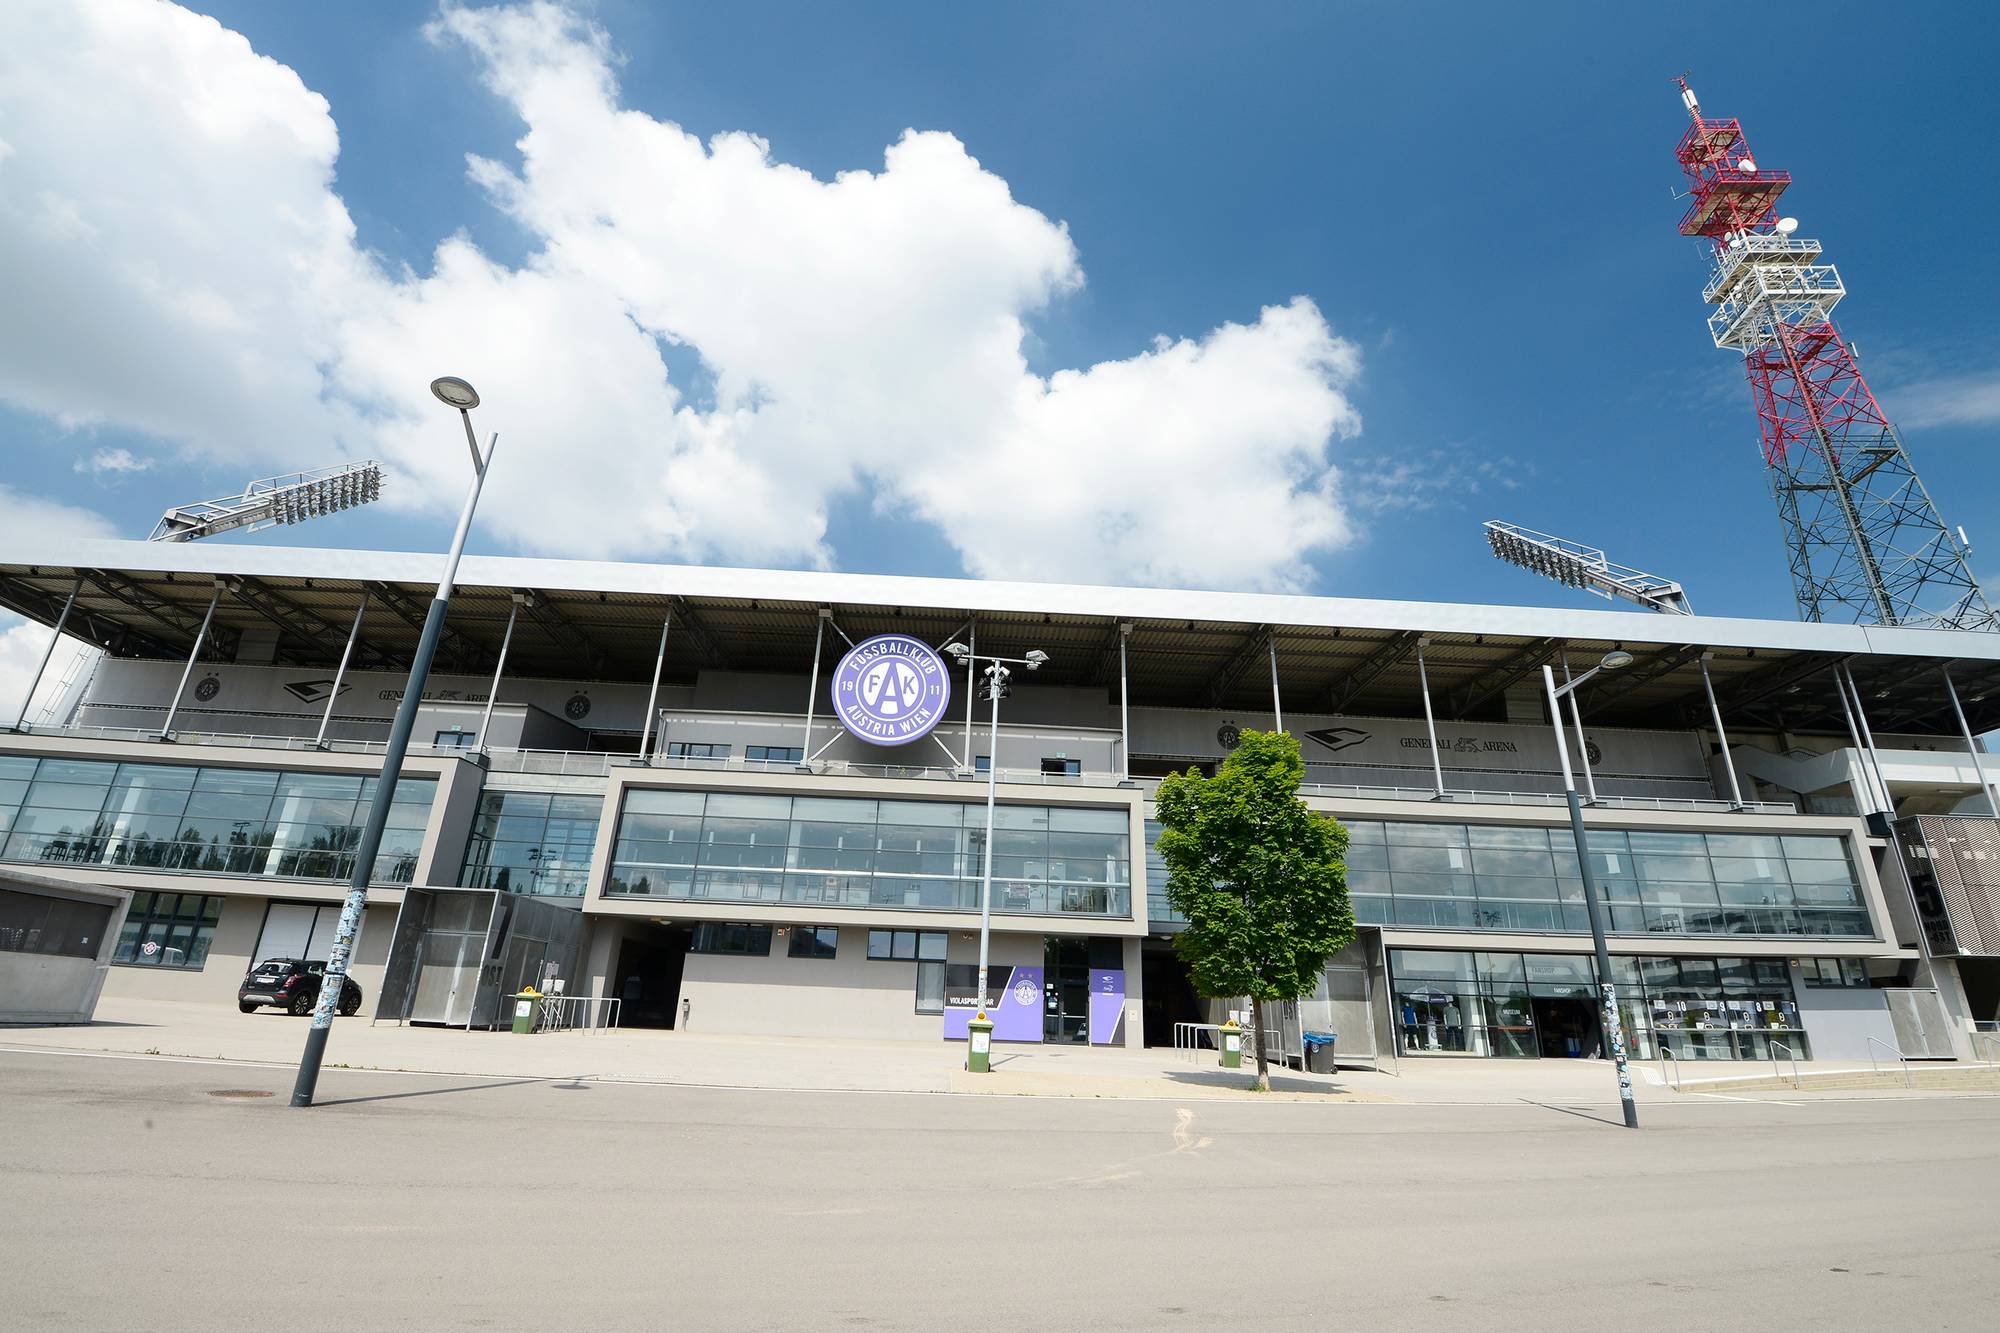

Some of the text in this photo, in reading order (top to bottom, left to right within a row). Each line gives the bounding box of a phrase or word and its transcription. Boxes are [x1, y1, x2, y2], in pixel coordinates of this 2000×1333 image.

[849, 642, 936, 674] FUSSBALLKLUB
[842, 680, 853, 691] 19
[930, 685, 940, 695] 11
[846, 704, 931, 735] AUSTRIA WIEN
[1483, 741, 1517, 752] ARENA
[1911, 874, 1942, 917] 5
[482, 965, 502, 986] OST
[1676, 1001, 1687, 1011] 10
[1719, 1002, 1725, 1011] 9
[1755, 1002, 1762, 1012] 8
